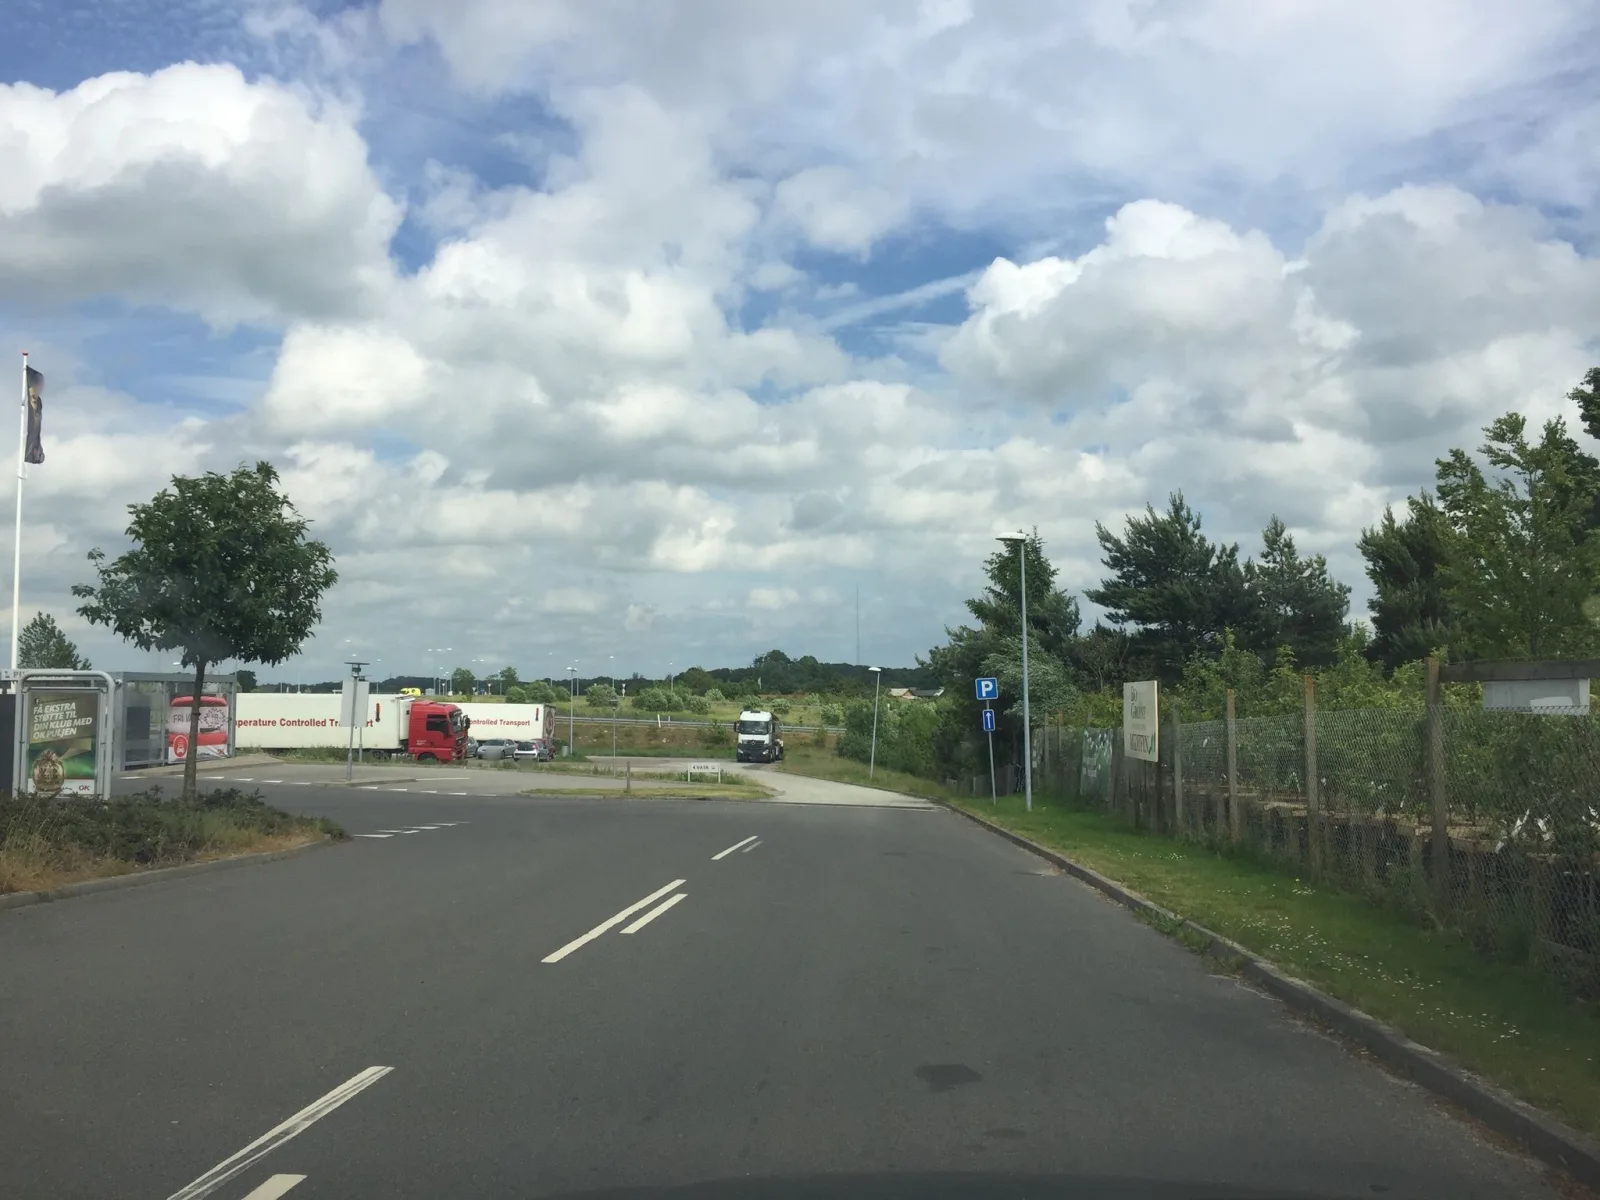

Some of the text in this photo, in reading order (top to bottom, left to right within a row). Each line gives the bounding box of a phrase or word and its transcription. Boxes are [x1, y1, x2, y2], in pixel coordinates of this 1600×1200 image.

[981, 680, 993, 697] P
[33, 702, 76, 715] FÅ EKSTRA
[33, 710, 77, 723] STØTTE TIL
[235, 719, 277, 727] perature
[280, 718, 327, 727] Controlled
[499, 719, 531, 727] Transport
[33, 717, 93, 731] DIN KLUB MED
[33, 727, 77, 740] OK PULJEN
